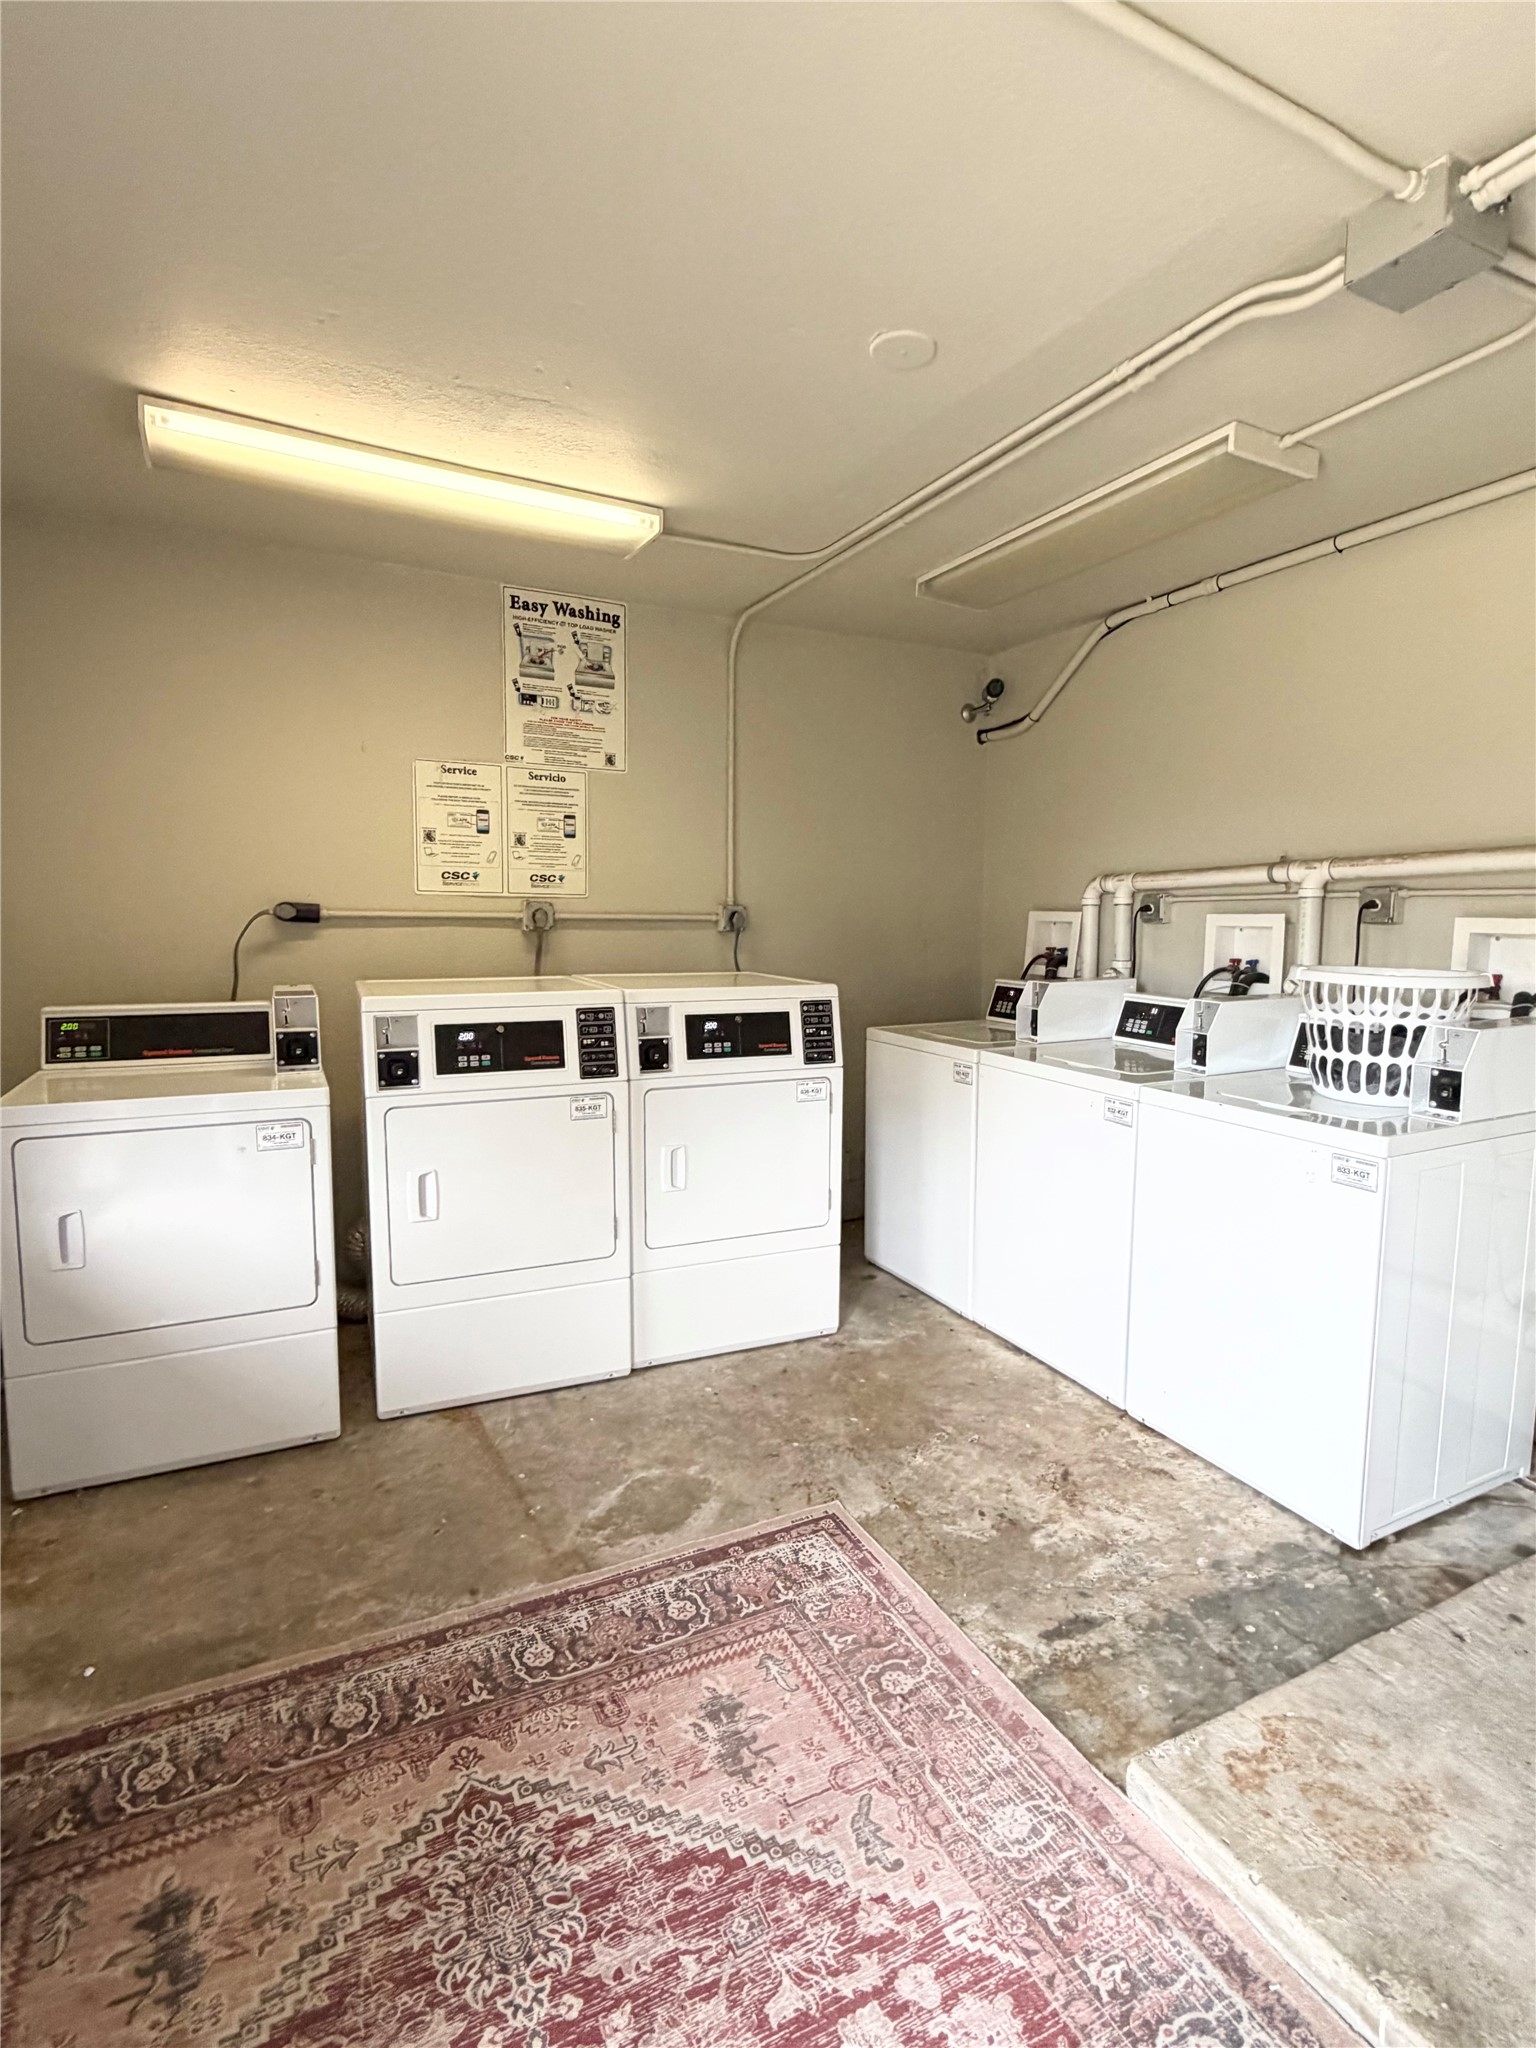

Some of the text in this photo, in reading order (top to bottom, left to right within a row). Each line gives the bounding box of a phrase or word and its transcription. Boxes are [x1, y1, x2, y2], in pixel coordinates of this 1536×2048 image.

[509, 594, 549, 618] Easy
[552, 600, 621, 629] Washing
[440, 764, 478, 777] Service
[528, 771, 567, 783] Servicio
[441, 870, 471, 880] CSC
[529, 873, 557, 883] CSC
[262, 1132, 296, 1142] 834-KGT
[1336, 1165, 1370, 1180] 833-KGT
